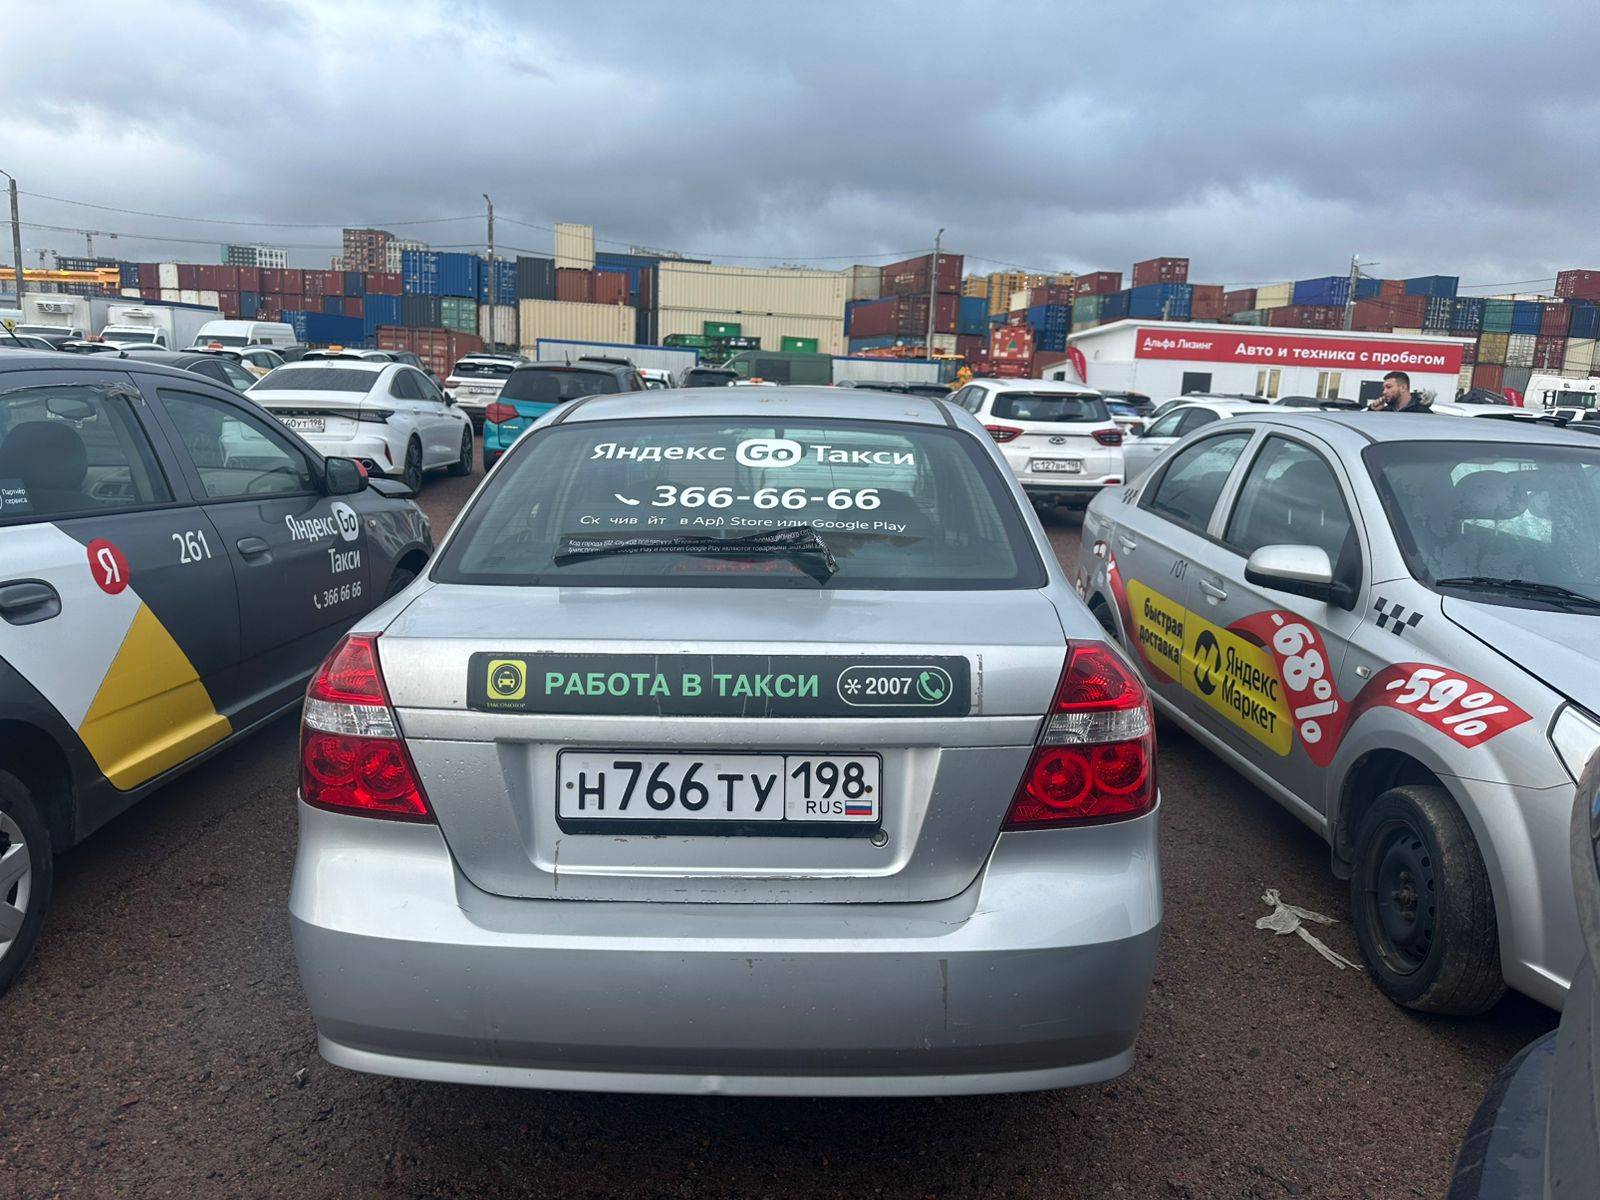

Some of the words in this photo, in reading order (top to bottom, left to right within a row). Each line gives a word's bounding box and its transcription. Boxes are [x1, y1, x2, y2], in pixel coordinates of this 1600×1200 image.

[1143, 337, 1175, 351] Альфа
[1177, 339, 1213, 351] Лизинг
[1235, 343, 1273, 357] Авто
[1278, 347, 1287, 357] и
[1293, 347, 1355, 361] техника
[1359, 351, 1368, 361] с
[1372, 351, 1446, 366] пробегом
[590, 443, 727, 462] Яндекс
[742, 443, 795, 462] Go
[809, 445, 916, 466] Такси
[651, 485, 882, 510] 366-66-66
[284, 514, 338, 542] Яндекс
[335, 507, 358, 534] Go
[680, 517, 689, 525] в
[730, 517, 773, 526] Store
[777, 519, 808, 527] или
[811, 519, 870, 530] Google
[873, 521, 907, 533] Play
[171, 529, 212, 564] 261
[327, 547, 361, 574] Такси
[96, 547, 121, 585] Я
[323, 587, 339, 608] 366
[340, 584, 351, 602] 66
[352, 581, 362, 598] 66
[1143, 597, 1184, 639] быстрая
[1139, 624, 1180, 665] доставка
[545, 672, 671, 697] РАБОТА
[681, 673, 703, 697] В
[712, 674, 820, 698] ТАКСИ
[1225, 646, 1279, 702] Яндекс
[1270, 613, 1339, 744] -68%
[1221, 674, 1277, 735] Маркет
[1385, 668, 1509, 737] -59%
[578, 761, 778, 812] Н766ТУ
[791, 760, 866, 799] 198
[805, 800, 844, 815] RUS
